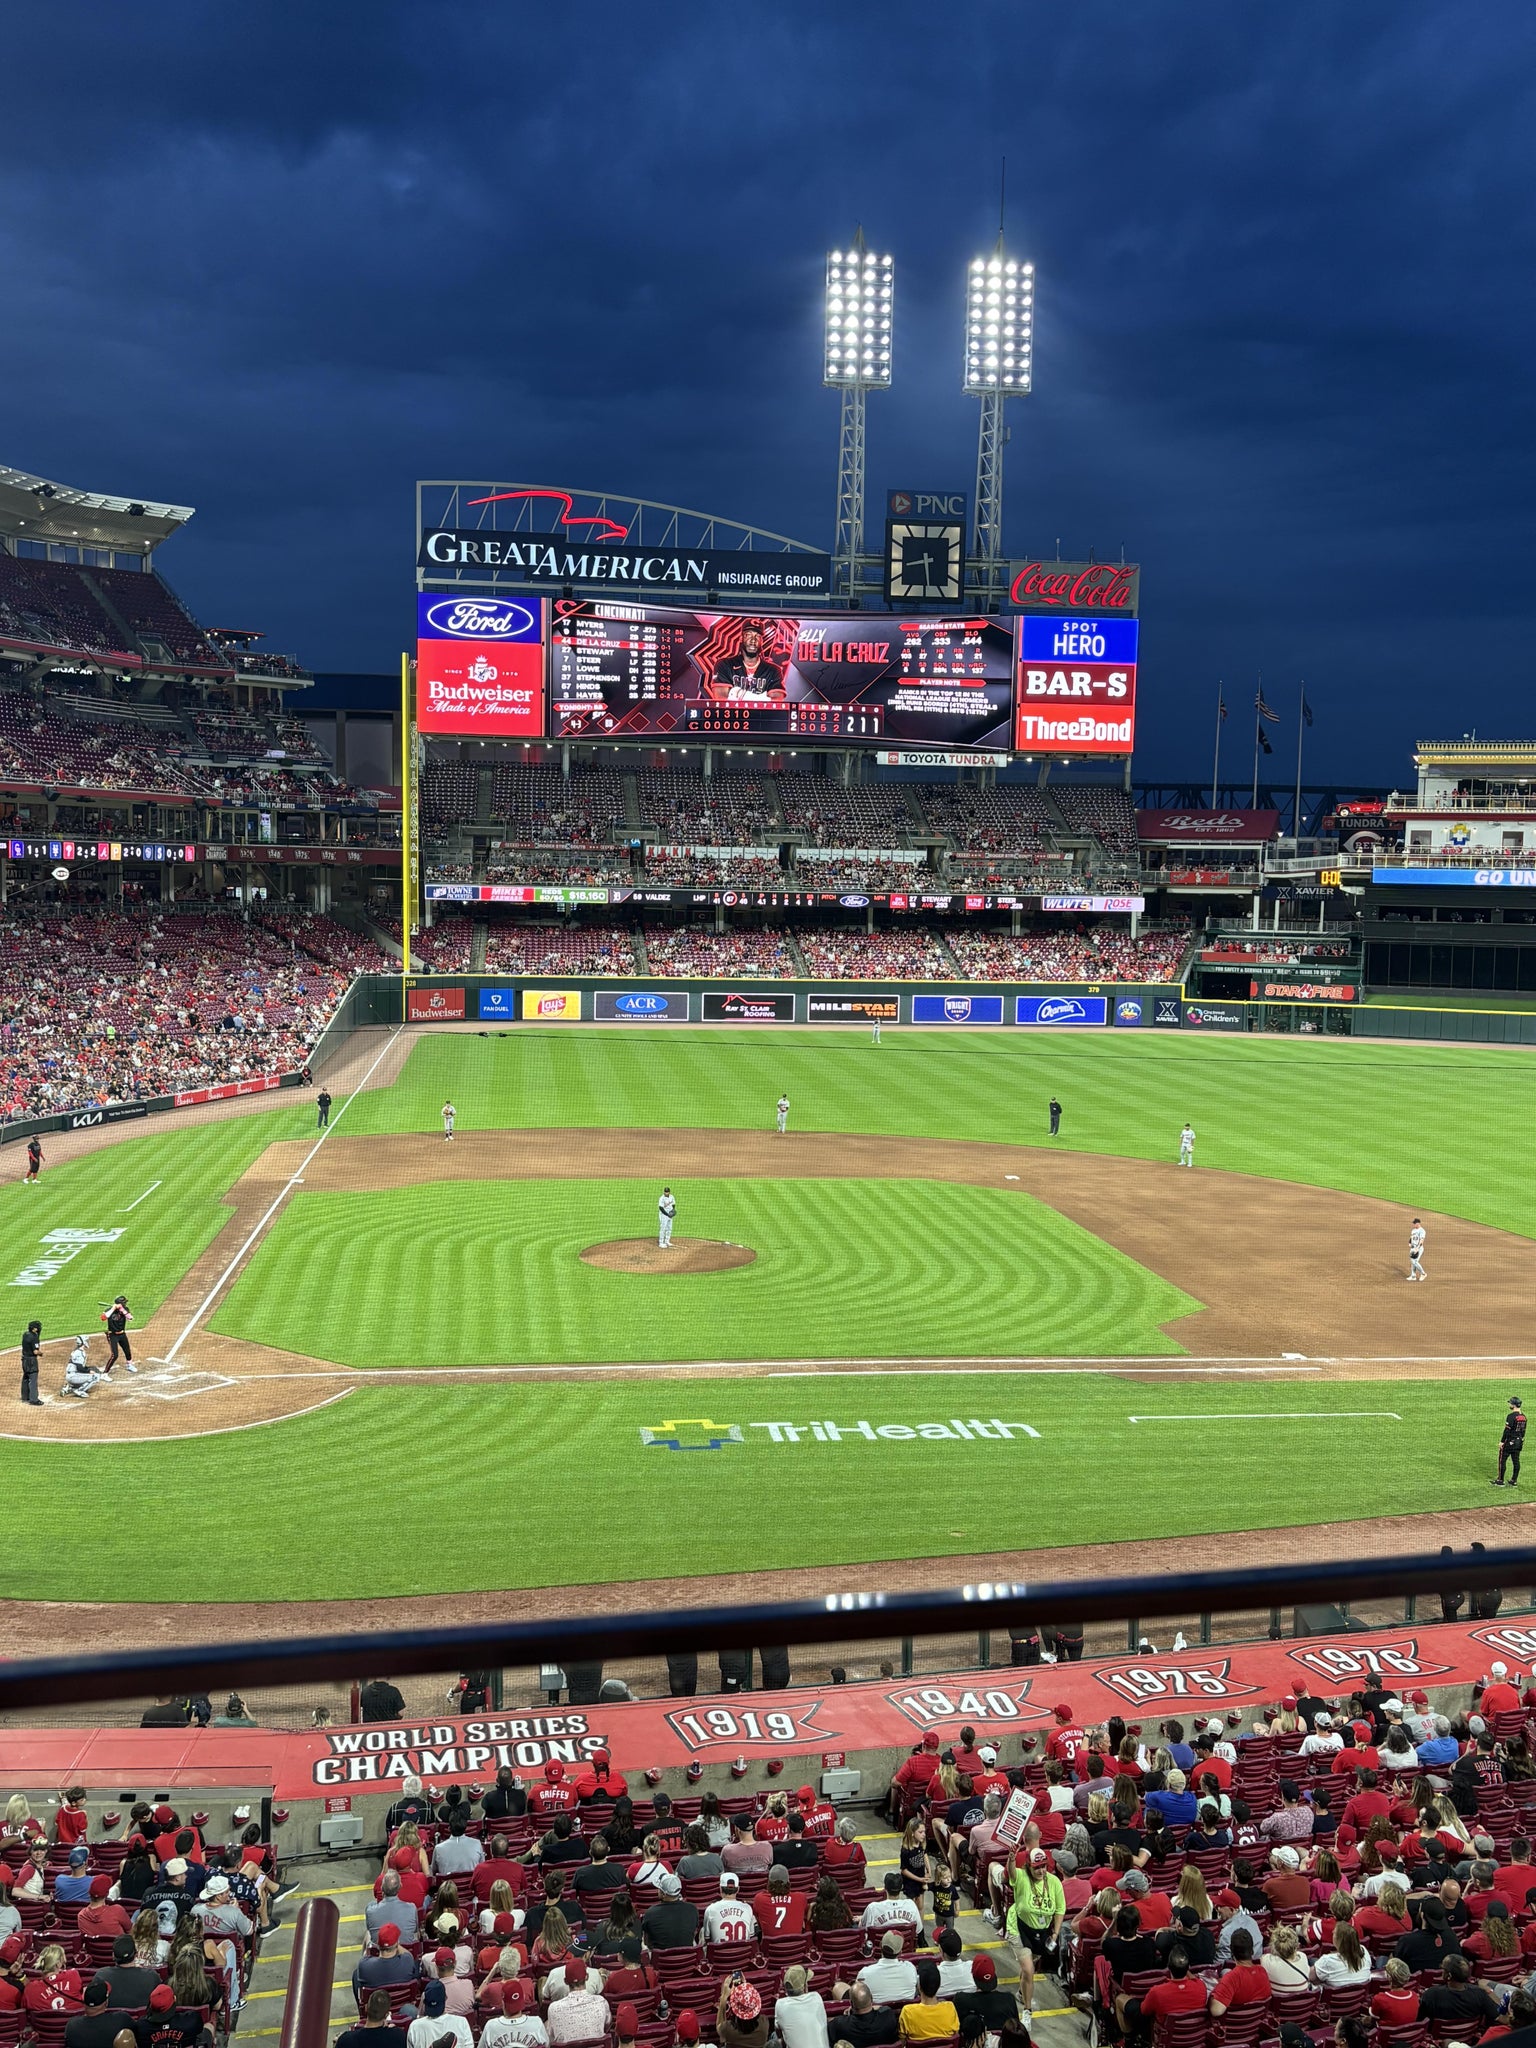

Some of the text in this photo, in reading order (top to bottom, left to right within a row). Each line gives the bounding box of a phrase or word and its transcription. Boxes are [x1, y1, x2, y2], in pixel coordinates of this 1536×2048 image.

[915, 494, 964, 515] PNC
[426, 532, 823, 588] GREAT AMERICAN INSURANCE GROUP
[1010, 563, 1138, 607] Coca-Cola
[447, 603, 513, 632] Ford
[595, 604, 645, 620] CINCINNATI
[576, 620, 604, 629] MYERS
[1062, 622, 1098, 632] SPOT
[576, 629, 606, 638] MCLAIN
[600, 640, 620, 648] CRUZ
[1054, 634, 1105, 657] HERO
[576, 648, 614, 656] STEWART
[798, 642, 889, 664] DE LA CRUZ
[576, 674, 620, 682] STEPHENSON
[1026, 671, 1127, 697] BAR-S
[429, 680, 533, 702] Budweiser
[426, 701, 531, 716] Made of America
[1022, 716, 1131, 741] ThreeBond
[903, 754, 995, 764] TOYOTA TUNDRA
[1159, 814, 1245, 829] Reds
[1339, 819, 1384, 828] TUNDRA
[135, 846, 141, 857] 0
[1474, 870, 1503, 884] GO
[491, 888, 524, 896] MIKE'S
[1294, 887, 1334, 895] XAVIER
[844, 896, 863, 905] Ford
[1103, 898, 1132, 910] ROSE
[1264, 983, 1344, 999] STAR FIRE
[541, 998, 565, 1013] Lay's
[625, 998, 656, 1009] ACR
[810, 1002, 897, 1011] MILESTAR
[946, 1000, 968, 1011] WRIGHT
[1040, 1004, 1075, 1018] Charmin
[411, 1008, 463, 1018] Budweiser
[1203, 1014, 1240, 1023] Children's
[73, 1111, 103, 1128] KIA
[5, 1243, 88, 1286] BETMGM
[750, 1418, 1042, 1443] TriHealth
[1303, 1648, 1419, 1675] 1976
[1110, 1666, 1226, 1697] 1975
[904, 1689, 1019, 1718] 1940
[680, 1709, 797, 1742] 1919
[330, 1714, 588, 1755] WORLD SERIES
[315, 1737, 608, 1784] CHAMPIONS
[539, 1788, 569, 1800] GRIFFEY
[804, 1812, 832, 1829] DE LA CRUZ
[770, 1896, 792, 1904] STEER
[719, 1907, 745, 1919] GRIFFEY
[774, 1906, 787, 1929] 7
[877, 1914, 888, 1924] DE
[887, 1911, 898, 1920] LA
[719, 1920, 747, 1942] 30
[40, 1981, 71, 2000] INDIA
[151, 2029, 184, 2043] GRIFFEY
